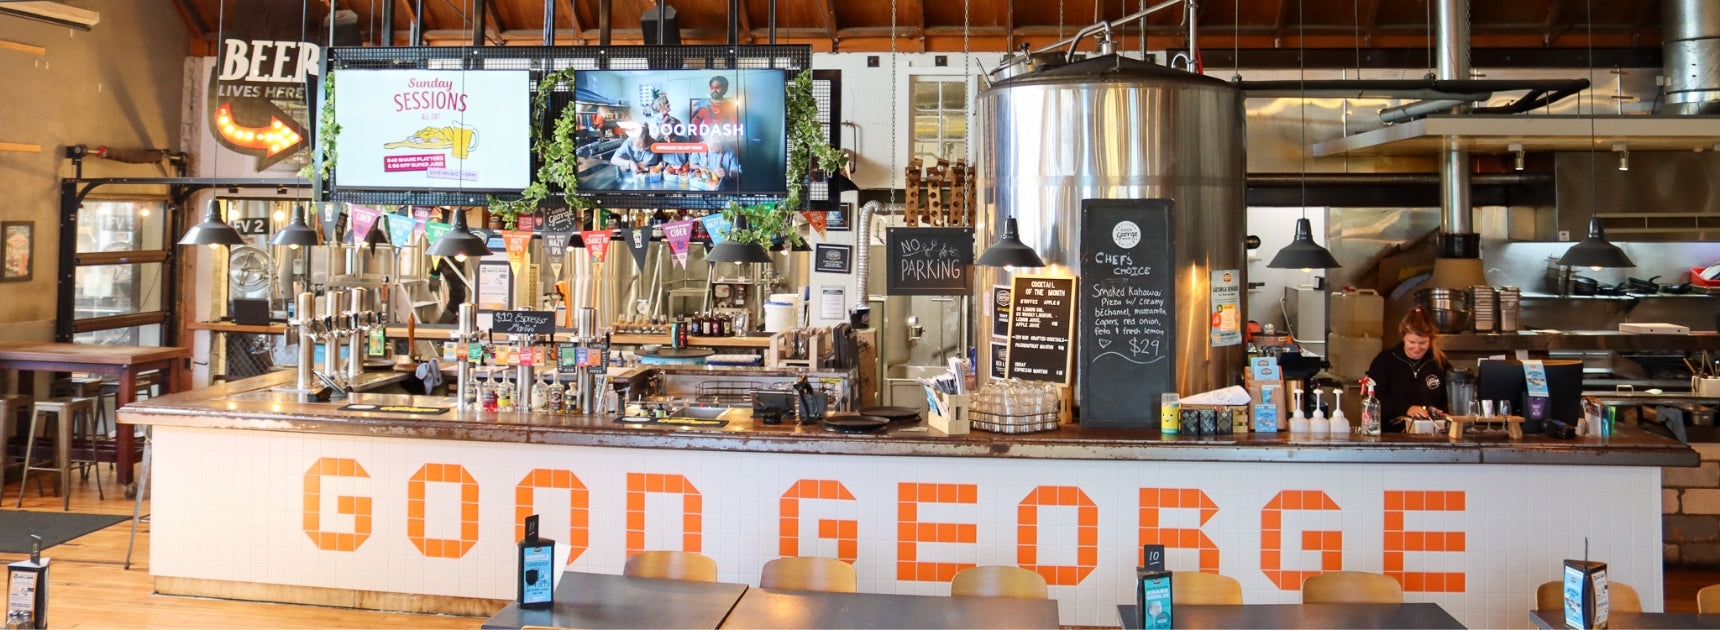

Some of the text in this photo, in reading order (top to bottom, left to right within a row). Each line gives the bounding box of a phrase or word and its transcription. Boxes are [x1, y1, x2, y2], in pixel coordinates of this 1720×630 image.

[218, 38, 320, 83] BEER
[218, 84, 304, 98] LIVES HERE
[408, 78, 452, 92] Sunday
[394, 91, 468, 112] SESSIONS
[649, 124, 744, 136] DOORDASH
[356, 213, 372, 223] CIDER
[255, 219, 264, 232] 2
[670, 228, 687, 238] CIDER
[552, 247, 562, 255] IPA
[901, 238, 920, 253] NO
[1114, 267, 1151, 276] CHOICE
[1092, 284, 1125, 298] Smoked
[514, 312, 548, 324] Espresso
[1129, 337, 1160, 357] $29
[302, 457, 1466, 592] GOOD GEORGE
[1150, 551, 1159, 561] 10
